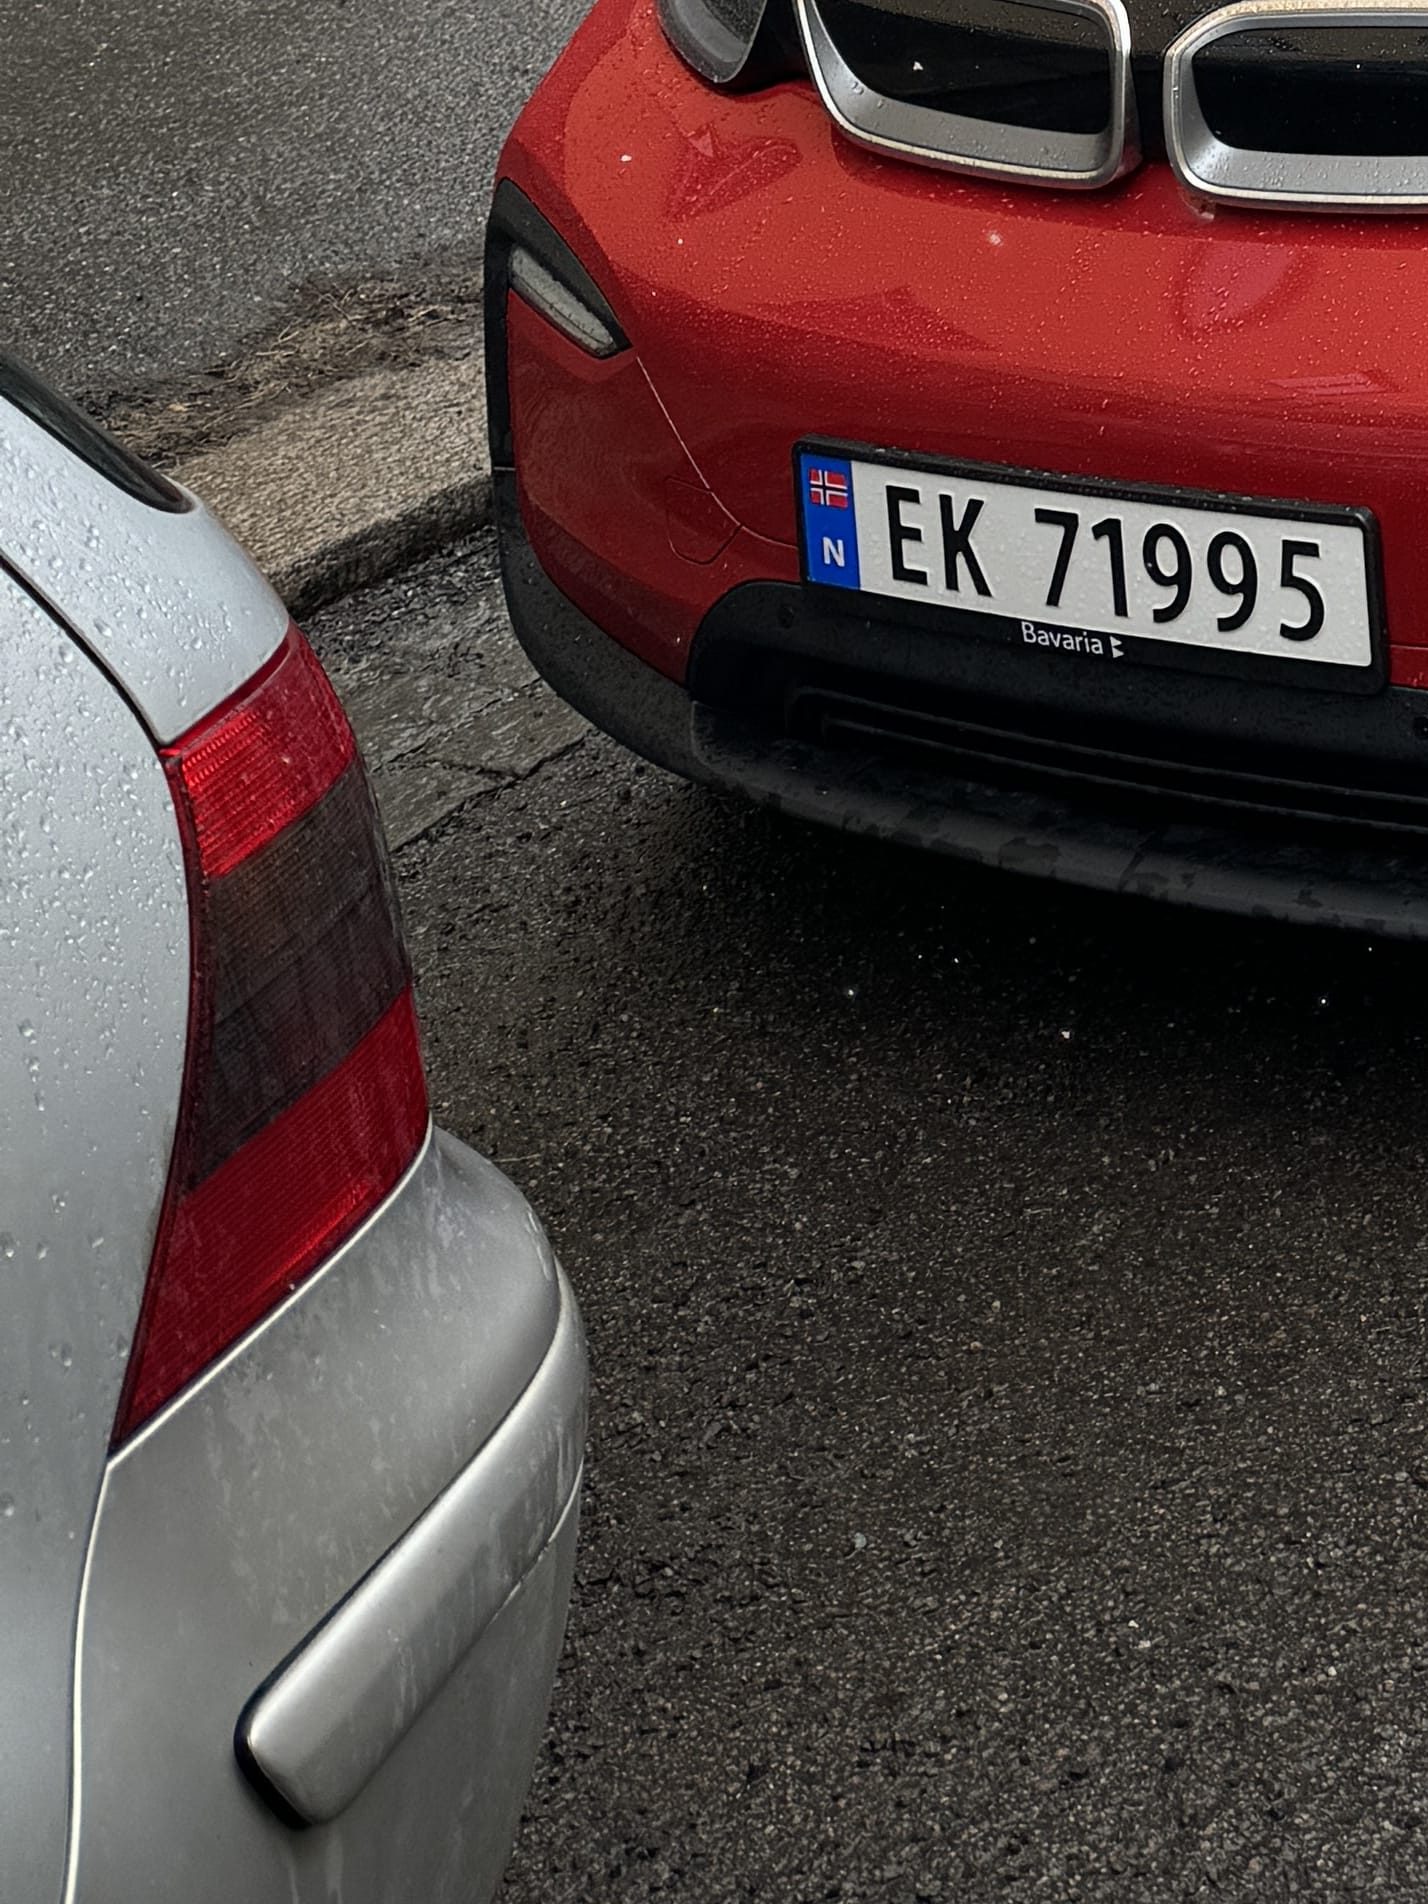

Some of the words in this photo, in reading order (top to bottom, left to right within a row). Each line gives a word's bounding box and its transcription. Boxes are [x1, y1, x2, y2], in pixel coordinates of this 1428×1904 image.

[822, 537, 845, 569] N
[886, 484, 992, 597] EK
[1034, 508, 1326, 642] 71995
[1021, 620, 1104, 655] Bavaria
